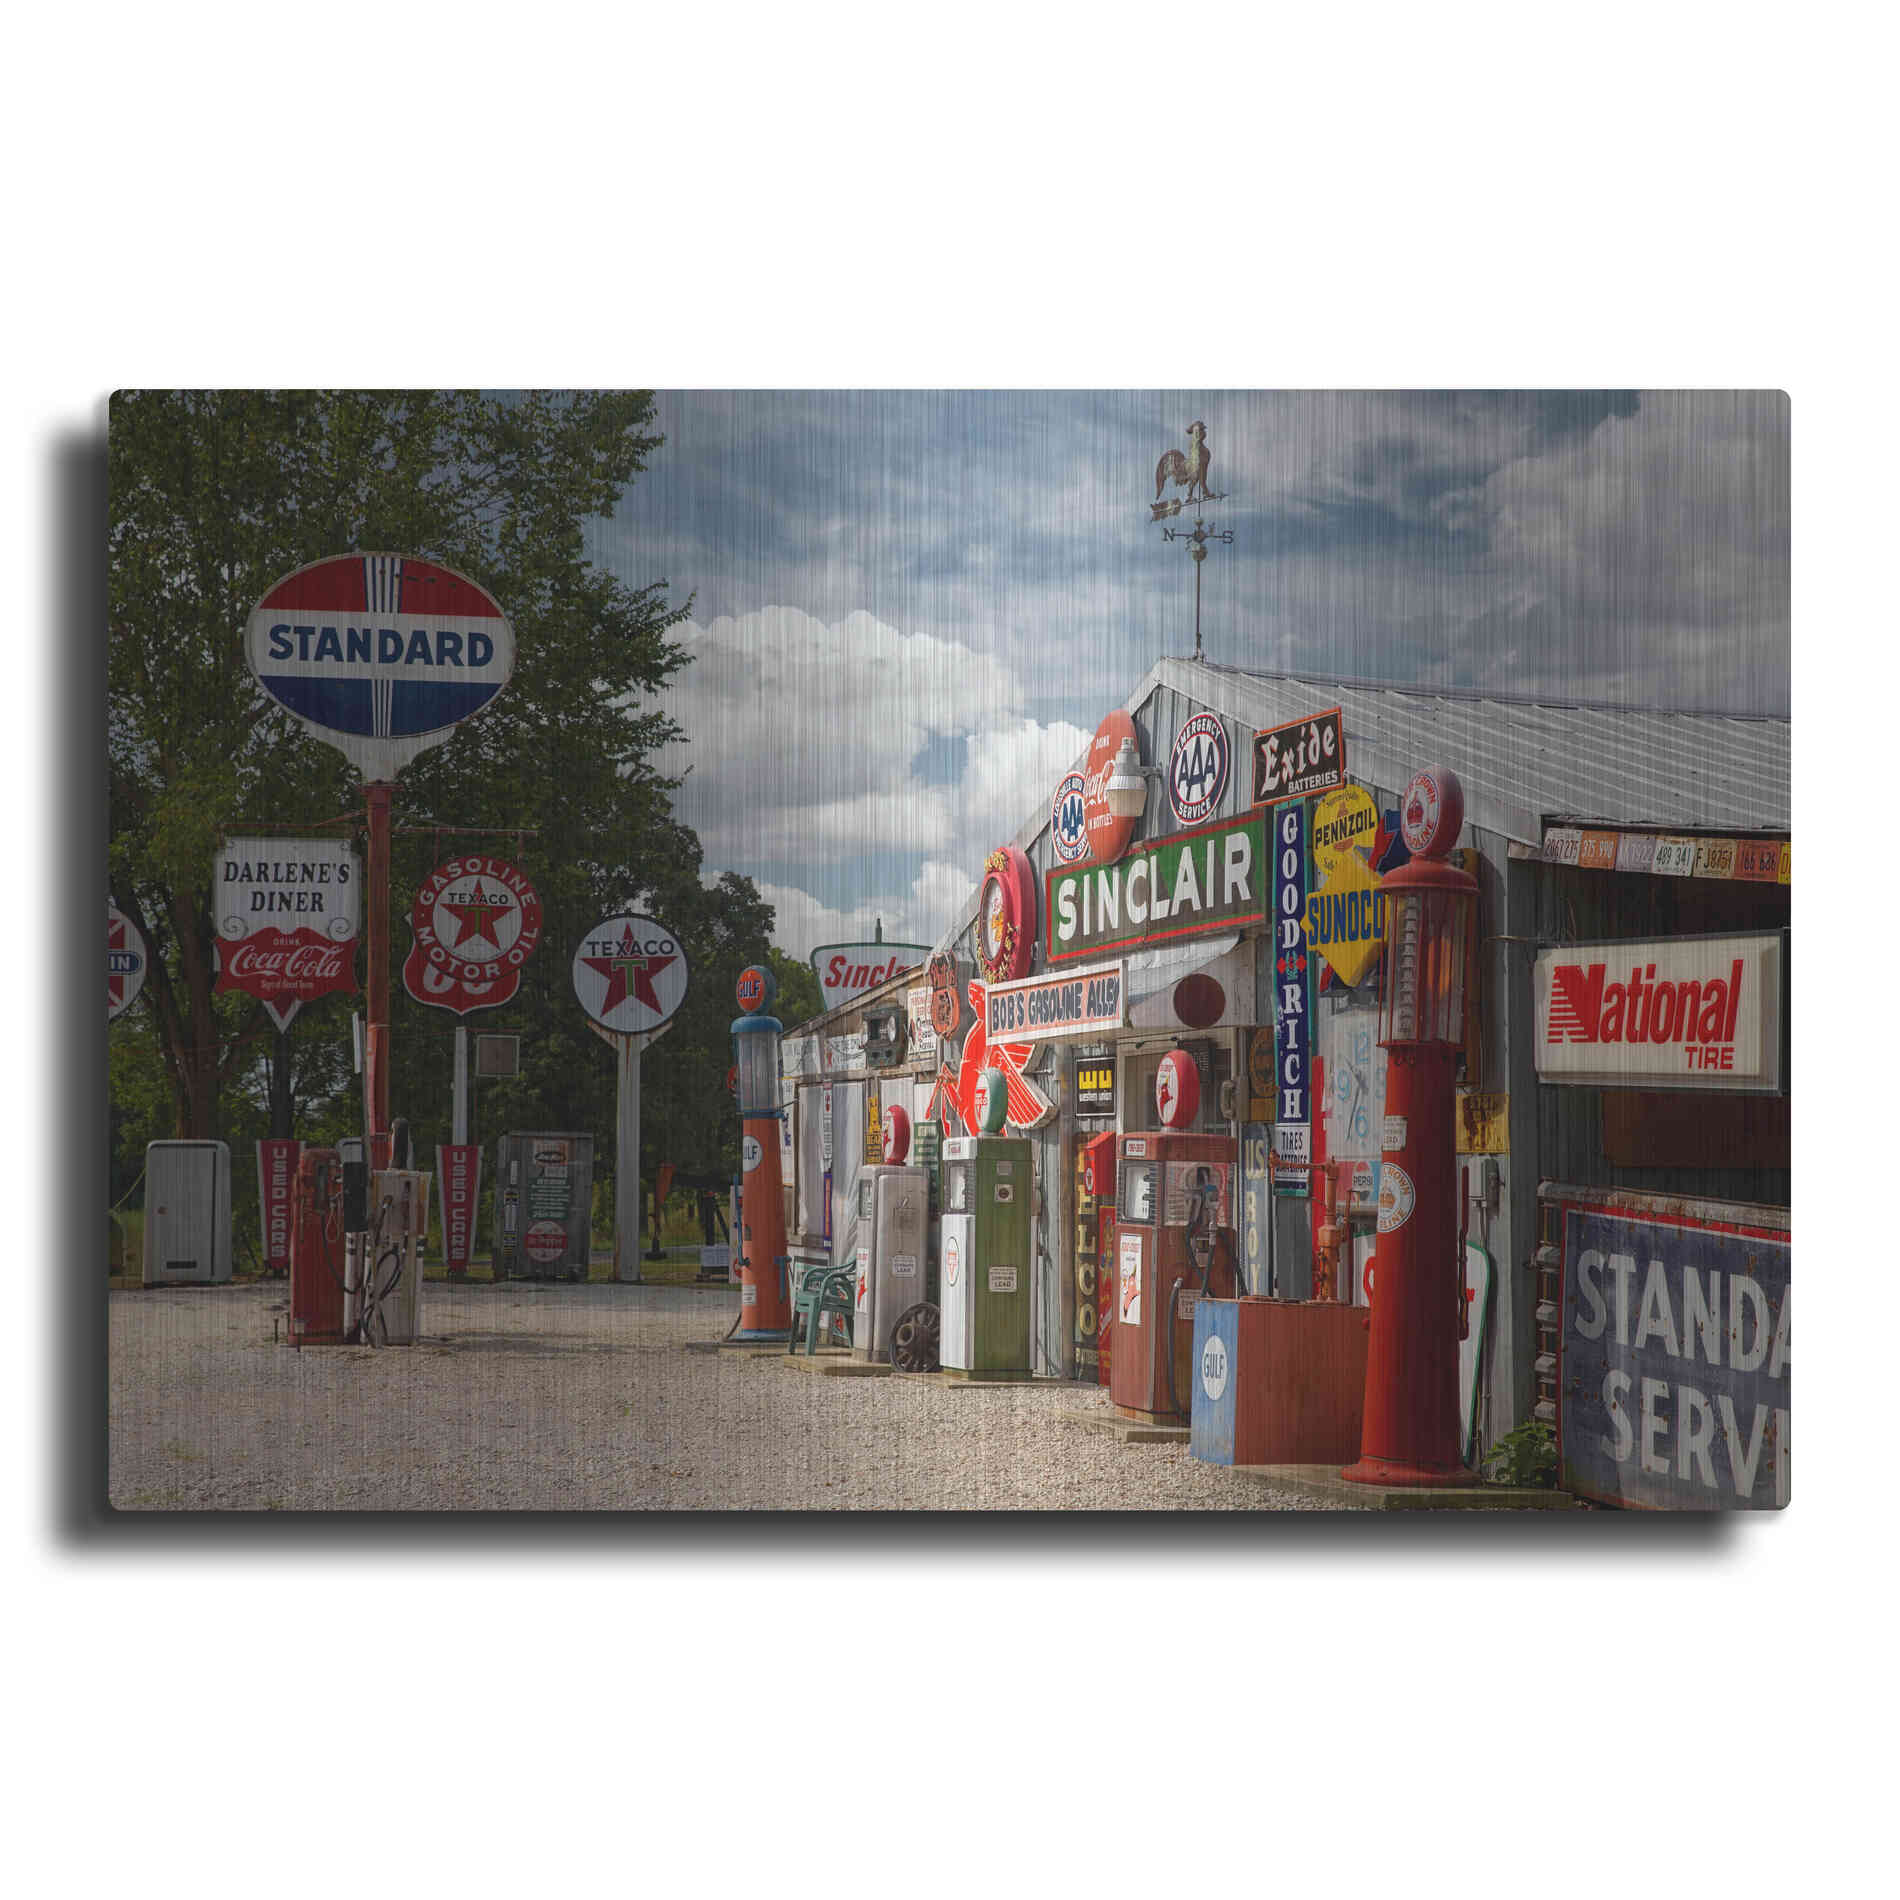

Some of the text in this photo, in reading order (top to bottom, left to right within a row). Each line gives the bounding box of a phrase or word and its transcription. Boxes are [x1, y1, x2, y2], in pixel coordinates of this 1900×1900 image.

[268, 623, 494, 667] STANDARD
[1176, 718, 1221, 754] EMERGENCY
[1178, 736, 1216, 800] AAA
[1260, 721, 1336, 797] Exide
[1288, 769, 1338, 793] BATTERIES
[1062, 795, 1084, 841] AAA
[1178, 797, 1211, 819] SERVICE
[1315, 807, 1375, 849] PENNZOIL
[223, 861, 350, 884] DARLENE'S
[420, 858, 537, 908] GASOLINE
[1058, 831, 1252, 941] SINCLAIR
[251, 891, 324, 912] DINER
[449, 892, 509, 905] TEXACO
[1308, 889, 1384, 946] SUNOCO
[229, 944, 345, 978] Coca-Cola
[418, 926, 538, 978] MOTOR OIL
[585, 940, 675, 956] TEXACO
[738, 982, 761, 999] GULF
[991, 991, 1025, 1032] BOB'S
[1028, 981, 1083, 1025] GASOLINE
[1087, 975, 1120, 1018] ALLEY
[1547, 958, 1745, 1044] National
[1685, 1046, 1734, 1070] TIRE
[1282, 1132, 1303, 1151] TIRES
[271, 1146, 288, 1258] USED CARS
[450, 1150, 468, 1261] USED CARS
[1203, 1353, 1226, 1380] GULF
